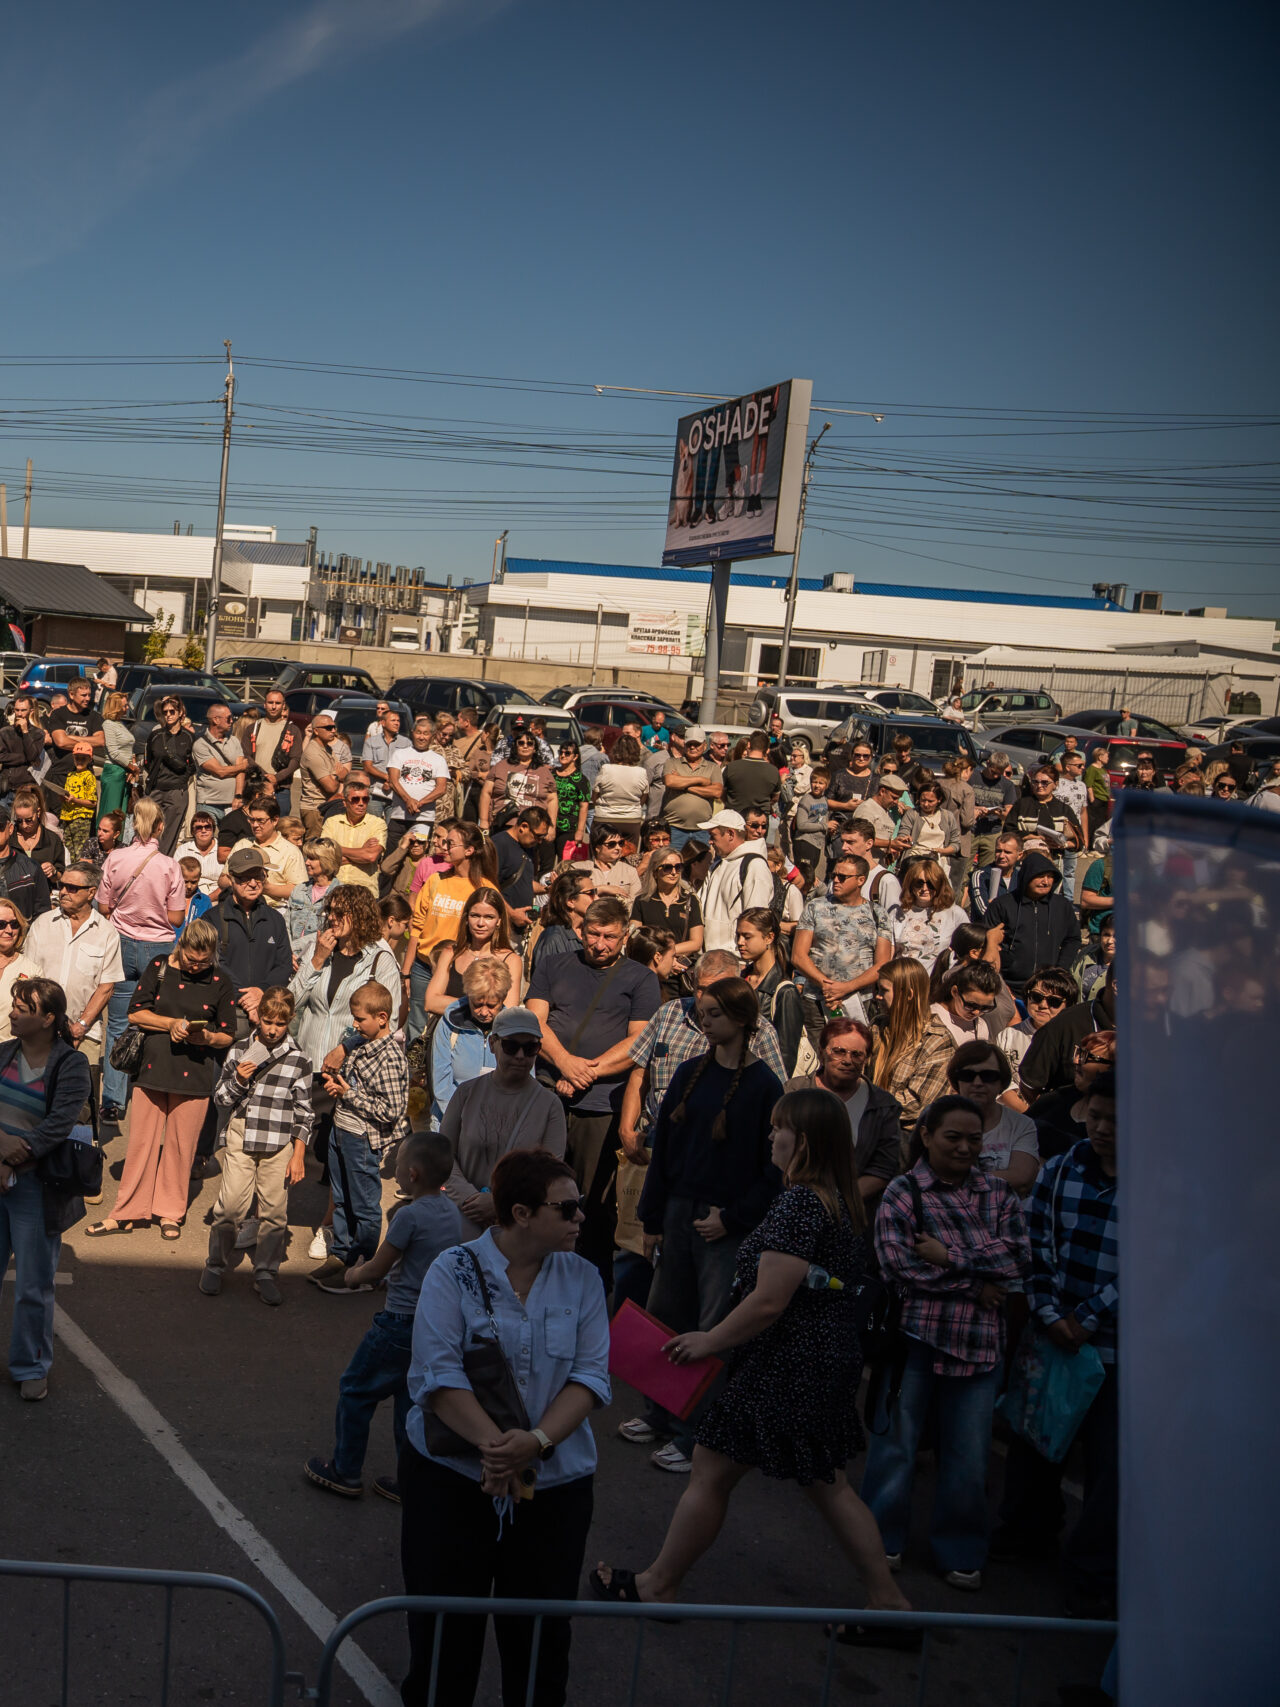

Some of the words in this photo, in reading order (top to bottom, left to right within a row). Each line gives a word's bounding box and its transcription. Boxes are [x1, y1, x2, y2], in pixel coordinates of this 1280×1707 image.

[688, 395, 772, 455] O'SHADE
[218, 615, 255, 624] БЛОНЬКА
[433, 896, 465, 911] ENERG
